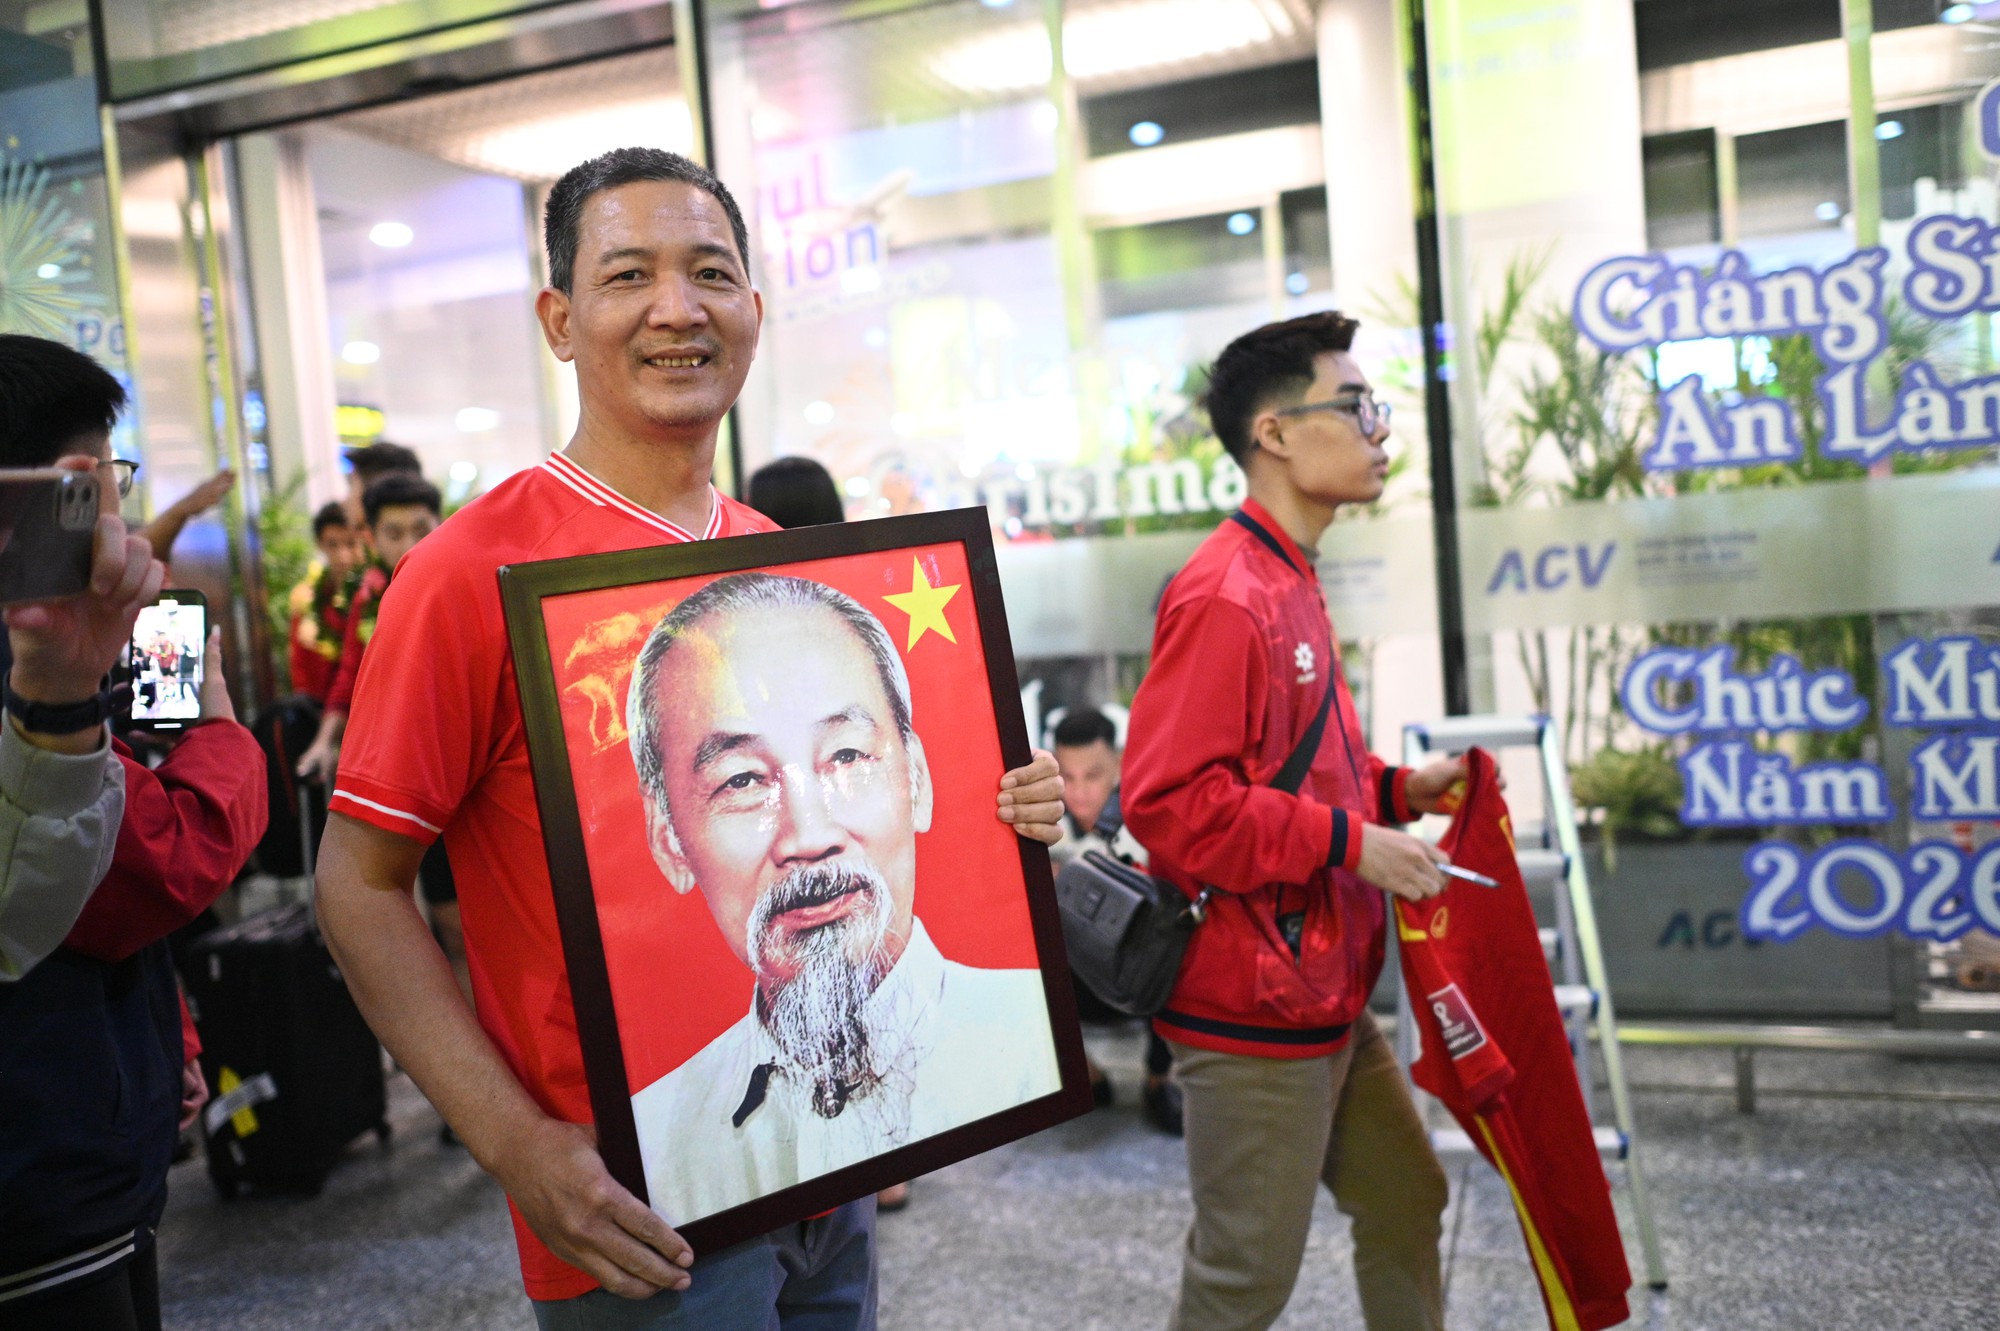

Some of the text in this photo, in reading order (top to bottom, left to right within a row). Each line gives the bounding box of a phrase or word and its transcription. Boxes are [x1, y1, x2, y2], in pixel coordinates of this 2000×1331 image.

[1577, 250, 1886, 366] Giáng
[1648, 377, 1795, 468] An
[1487, 542, 1616, 594] ACV
[1624, 647, 1864, 733] Chúc
[1684, 743, 1891, 823] Năm
[1657, 909, 1762, 949] AC
